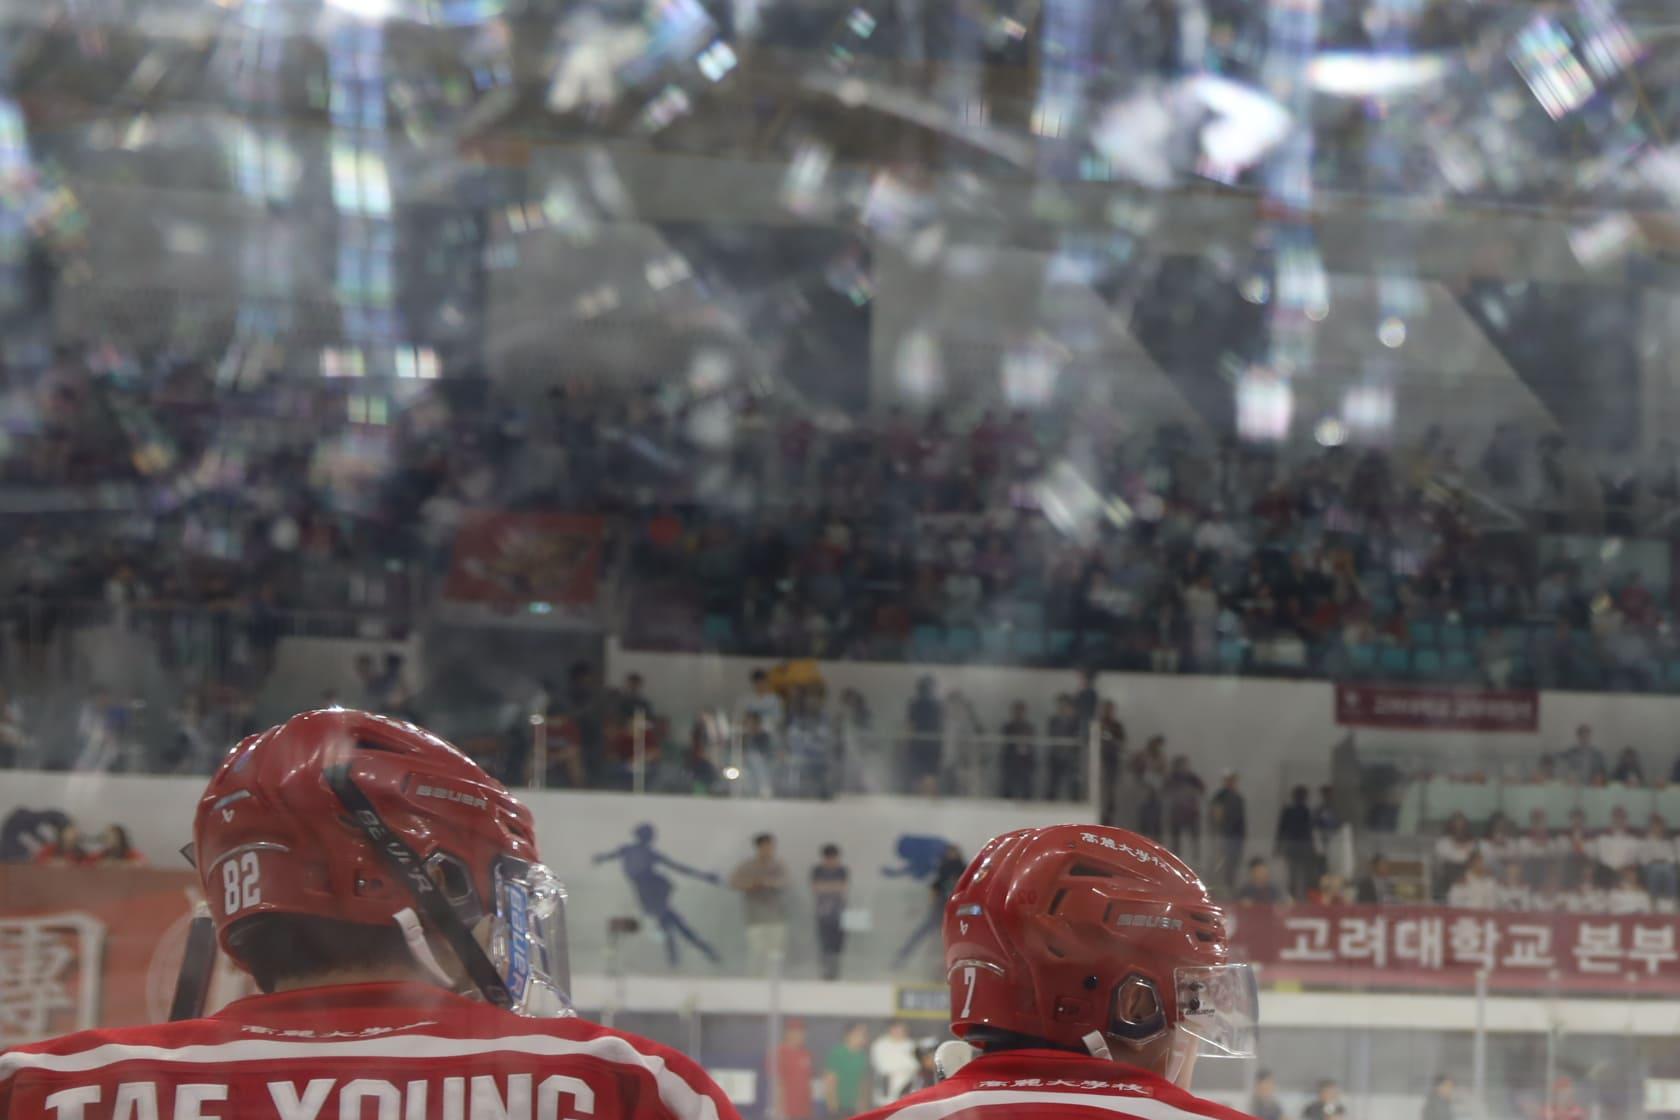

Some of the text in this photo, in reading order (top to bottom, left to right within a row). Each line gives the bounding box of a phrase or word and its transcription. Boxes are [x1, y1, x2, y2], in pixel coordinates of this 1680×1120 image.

[222, 850, 262, 917] 82
[1279, 915, 1554, 970] 고려대학교
[960, 966, 977, 1019] 7
